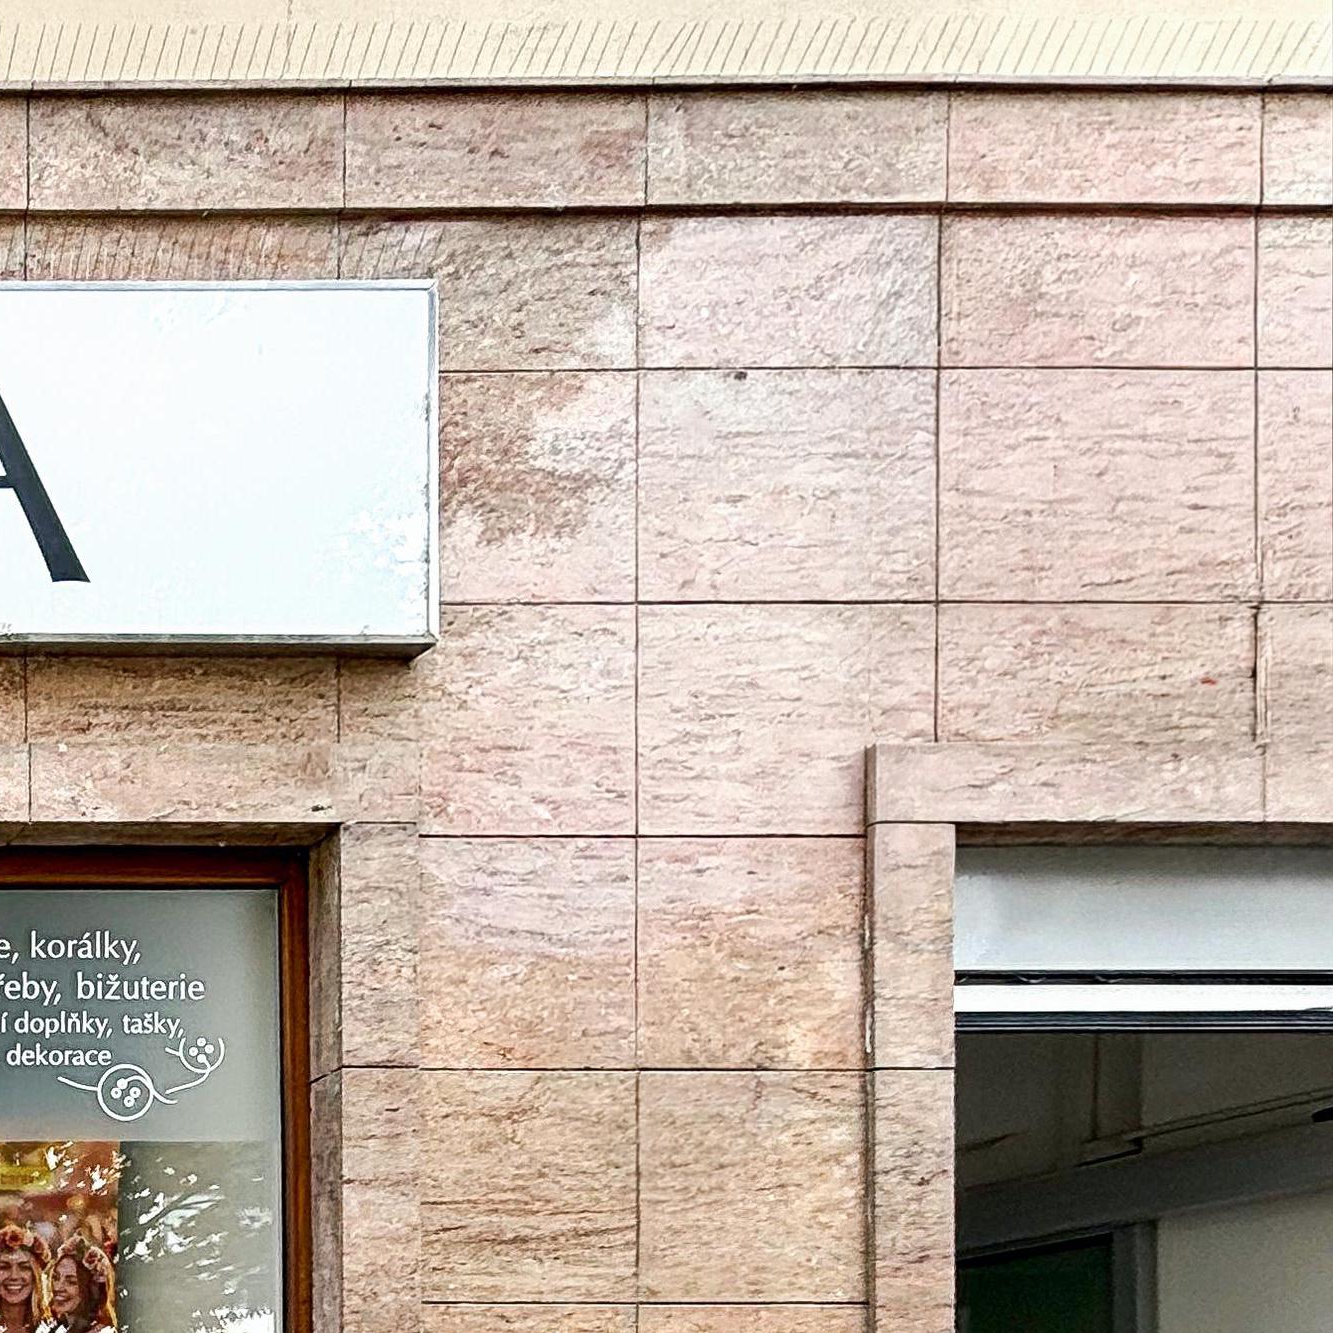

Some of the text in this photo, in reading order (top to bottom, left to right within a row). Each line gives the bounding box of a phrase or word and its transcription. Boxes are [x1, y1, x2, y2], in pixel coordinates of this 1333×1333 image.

[31, 930, 141, 966] korálky,
[76, 971, 206, 1001] bižuterie
[14, 1010, 113, 1039] doplňky,
[122, 1011, 184, 1039] tašky,
[6, 1042, 113, 1066] dekorace
